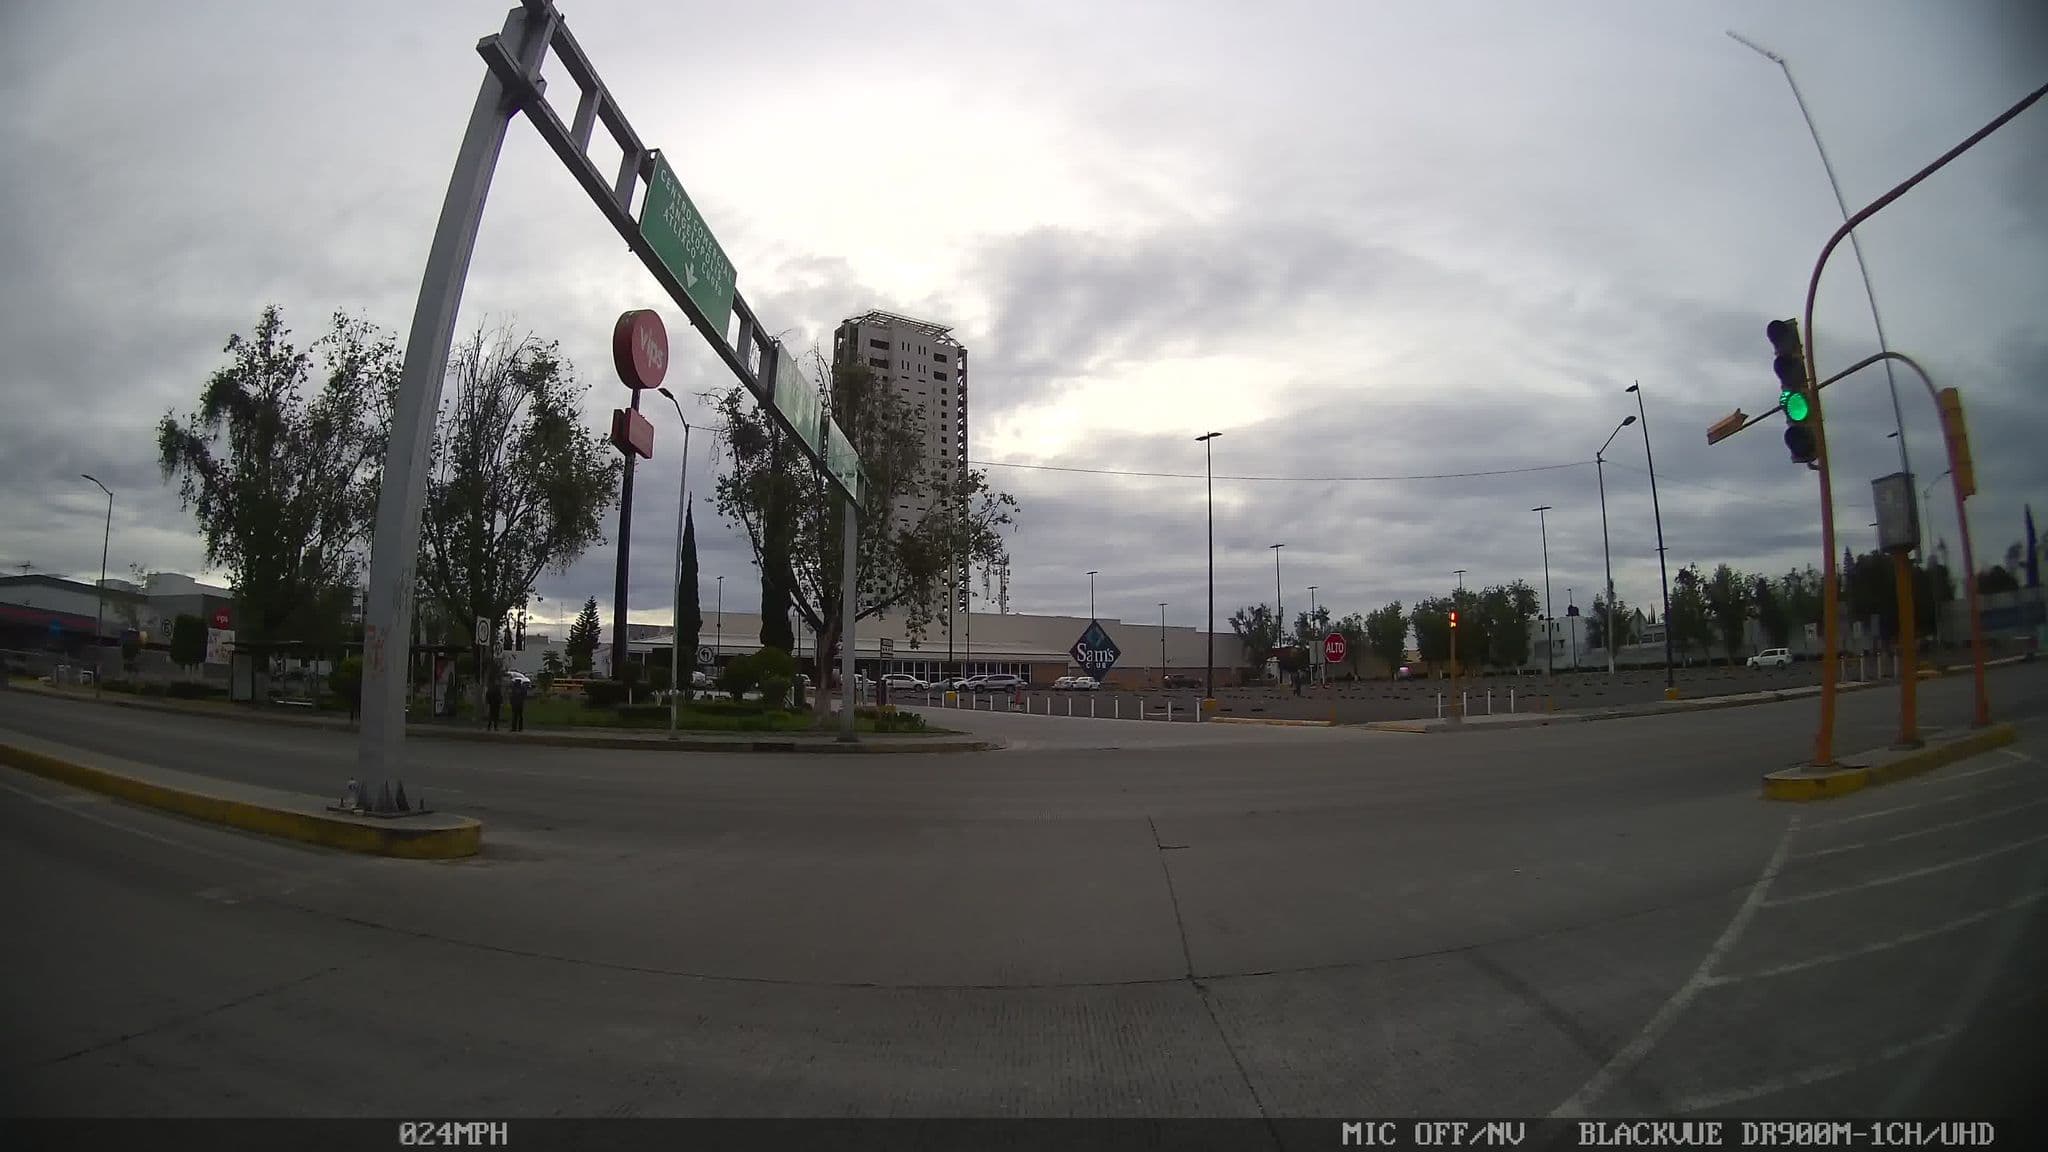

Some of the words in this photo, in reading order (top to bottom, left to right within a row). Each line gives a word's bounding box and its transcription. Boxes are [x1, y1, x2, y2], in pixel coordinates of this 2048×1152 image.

[660, 169, 692, 220] CENTRO
[693, 221, 732, 283] COMERCIAL
[663, 209, 697, 259] ATLIXCO
[669, 202, 722, 281] ANGELOPOLIS
[1076, 642, 1114, 662] Sam's
[1325, 641, 1344, 654] ALTO
